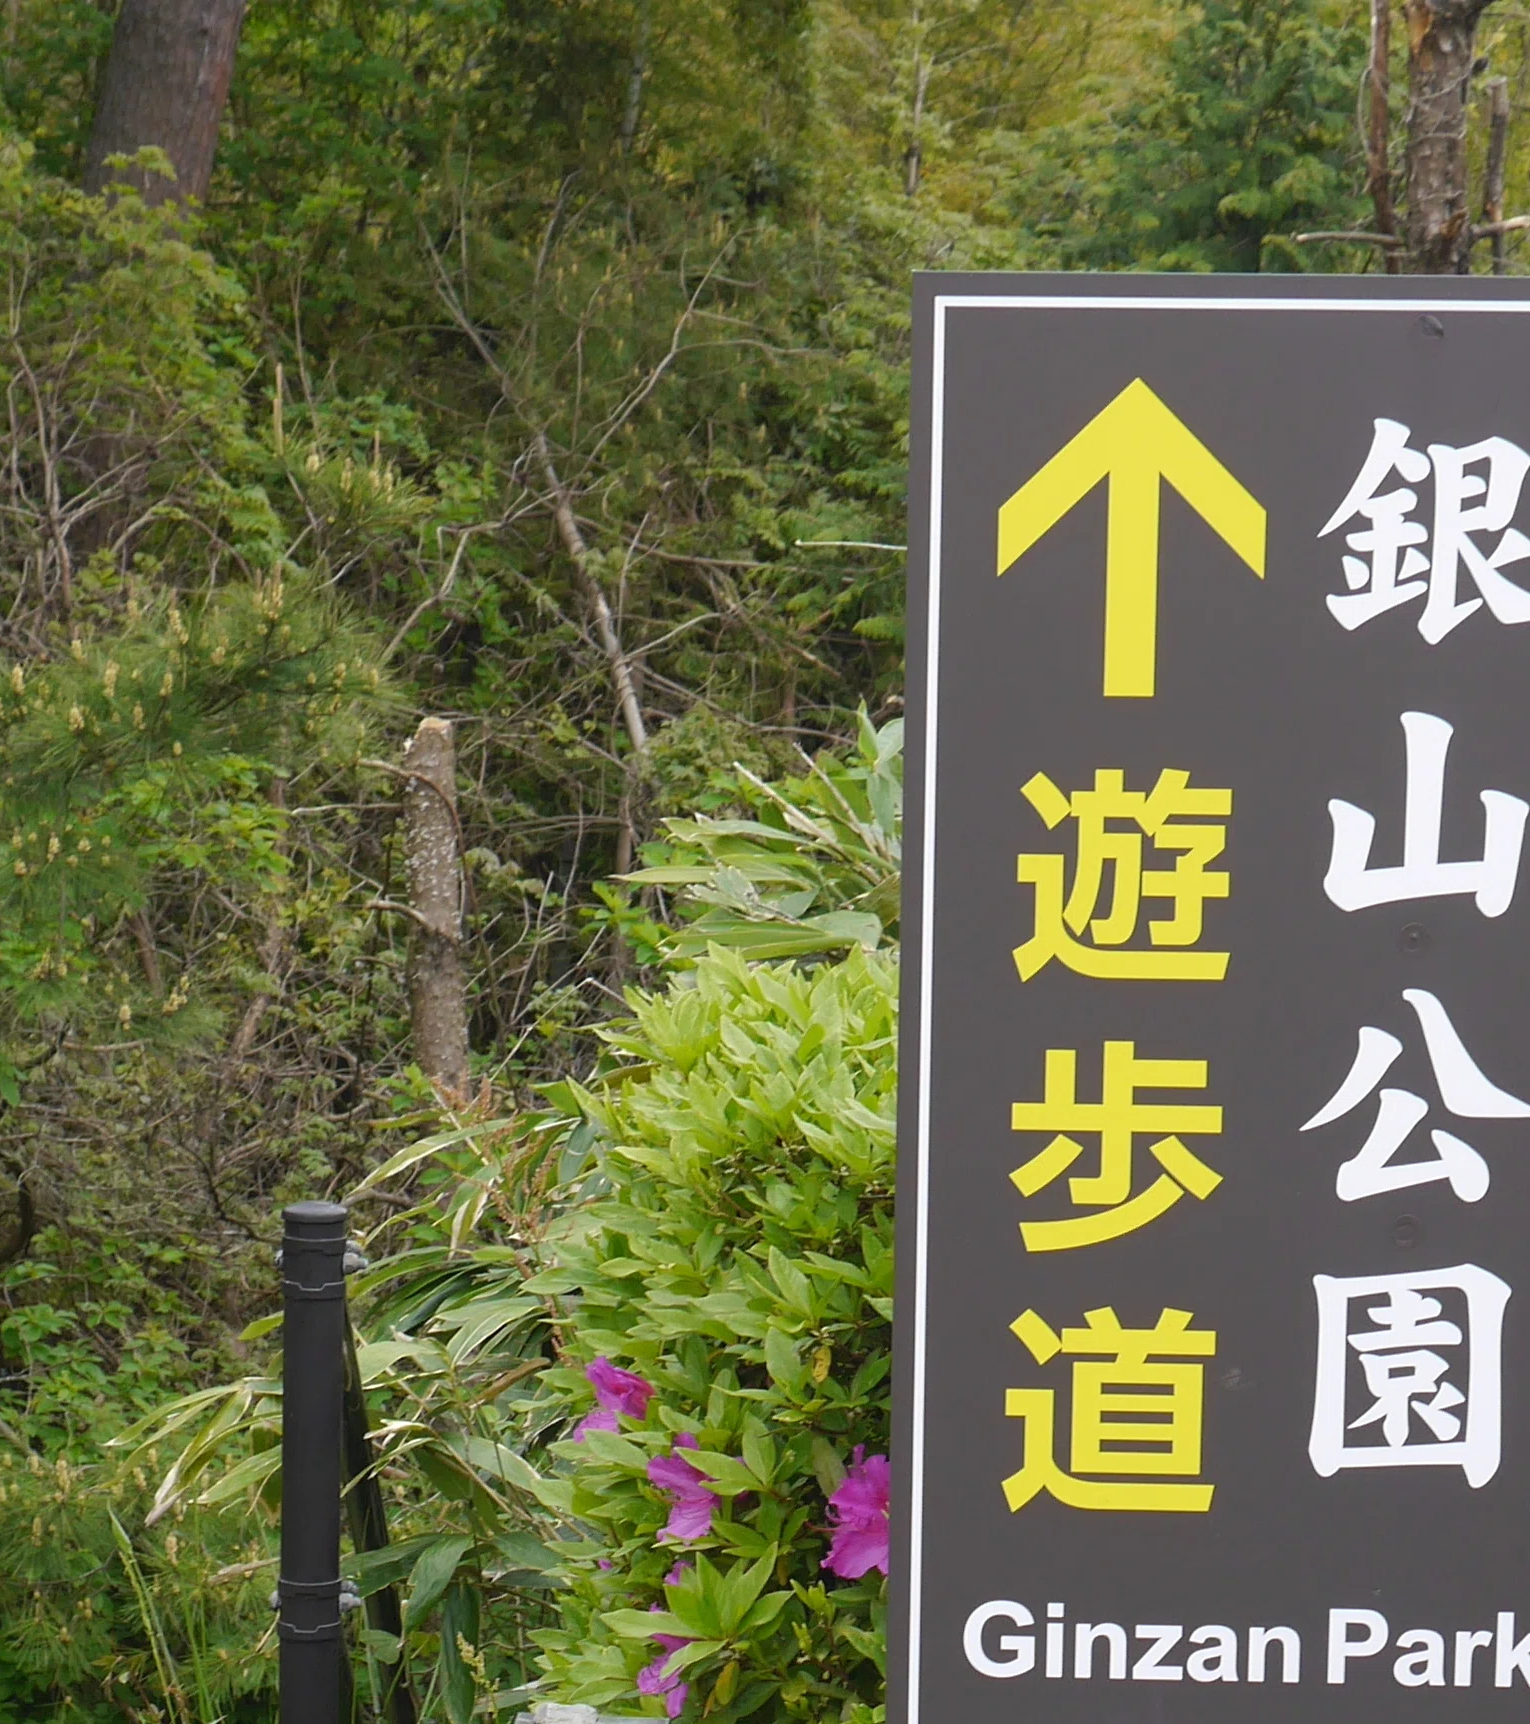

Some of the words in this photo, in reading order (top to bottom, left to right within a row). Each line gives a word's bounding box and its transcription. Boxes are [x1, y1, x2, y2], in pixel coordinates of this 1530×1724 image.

[1000, 766, 1233, 1514] 遊歩道
[962, 1599, 1303, 1685] Ginzan
